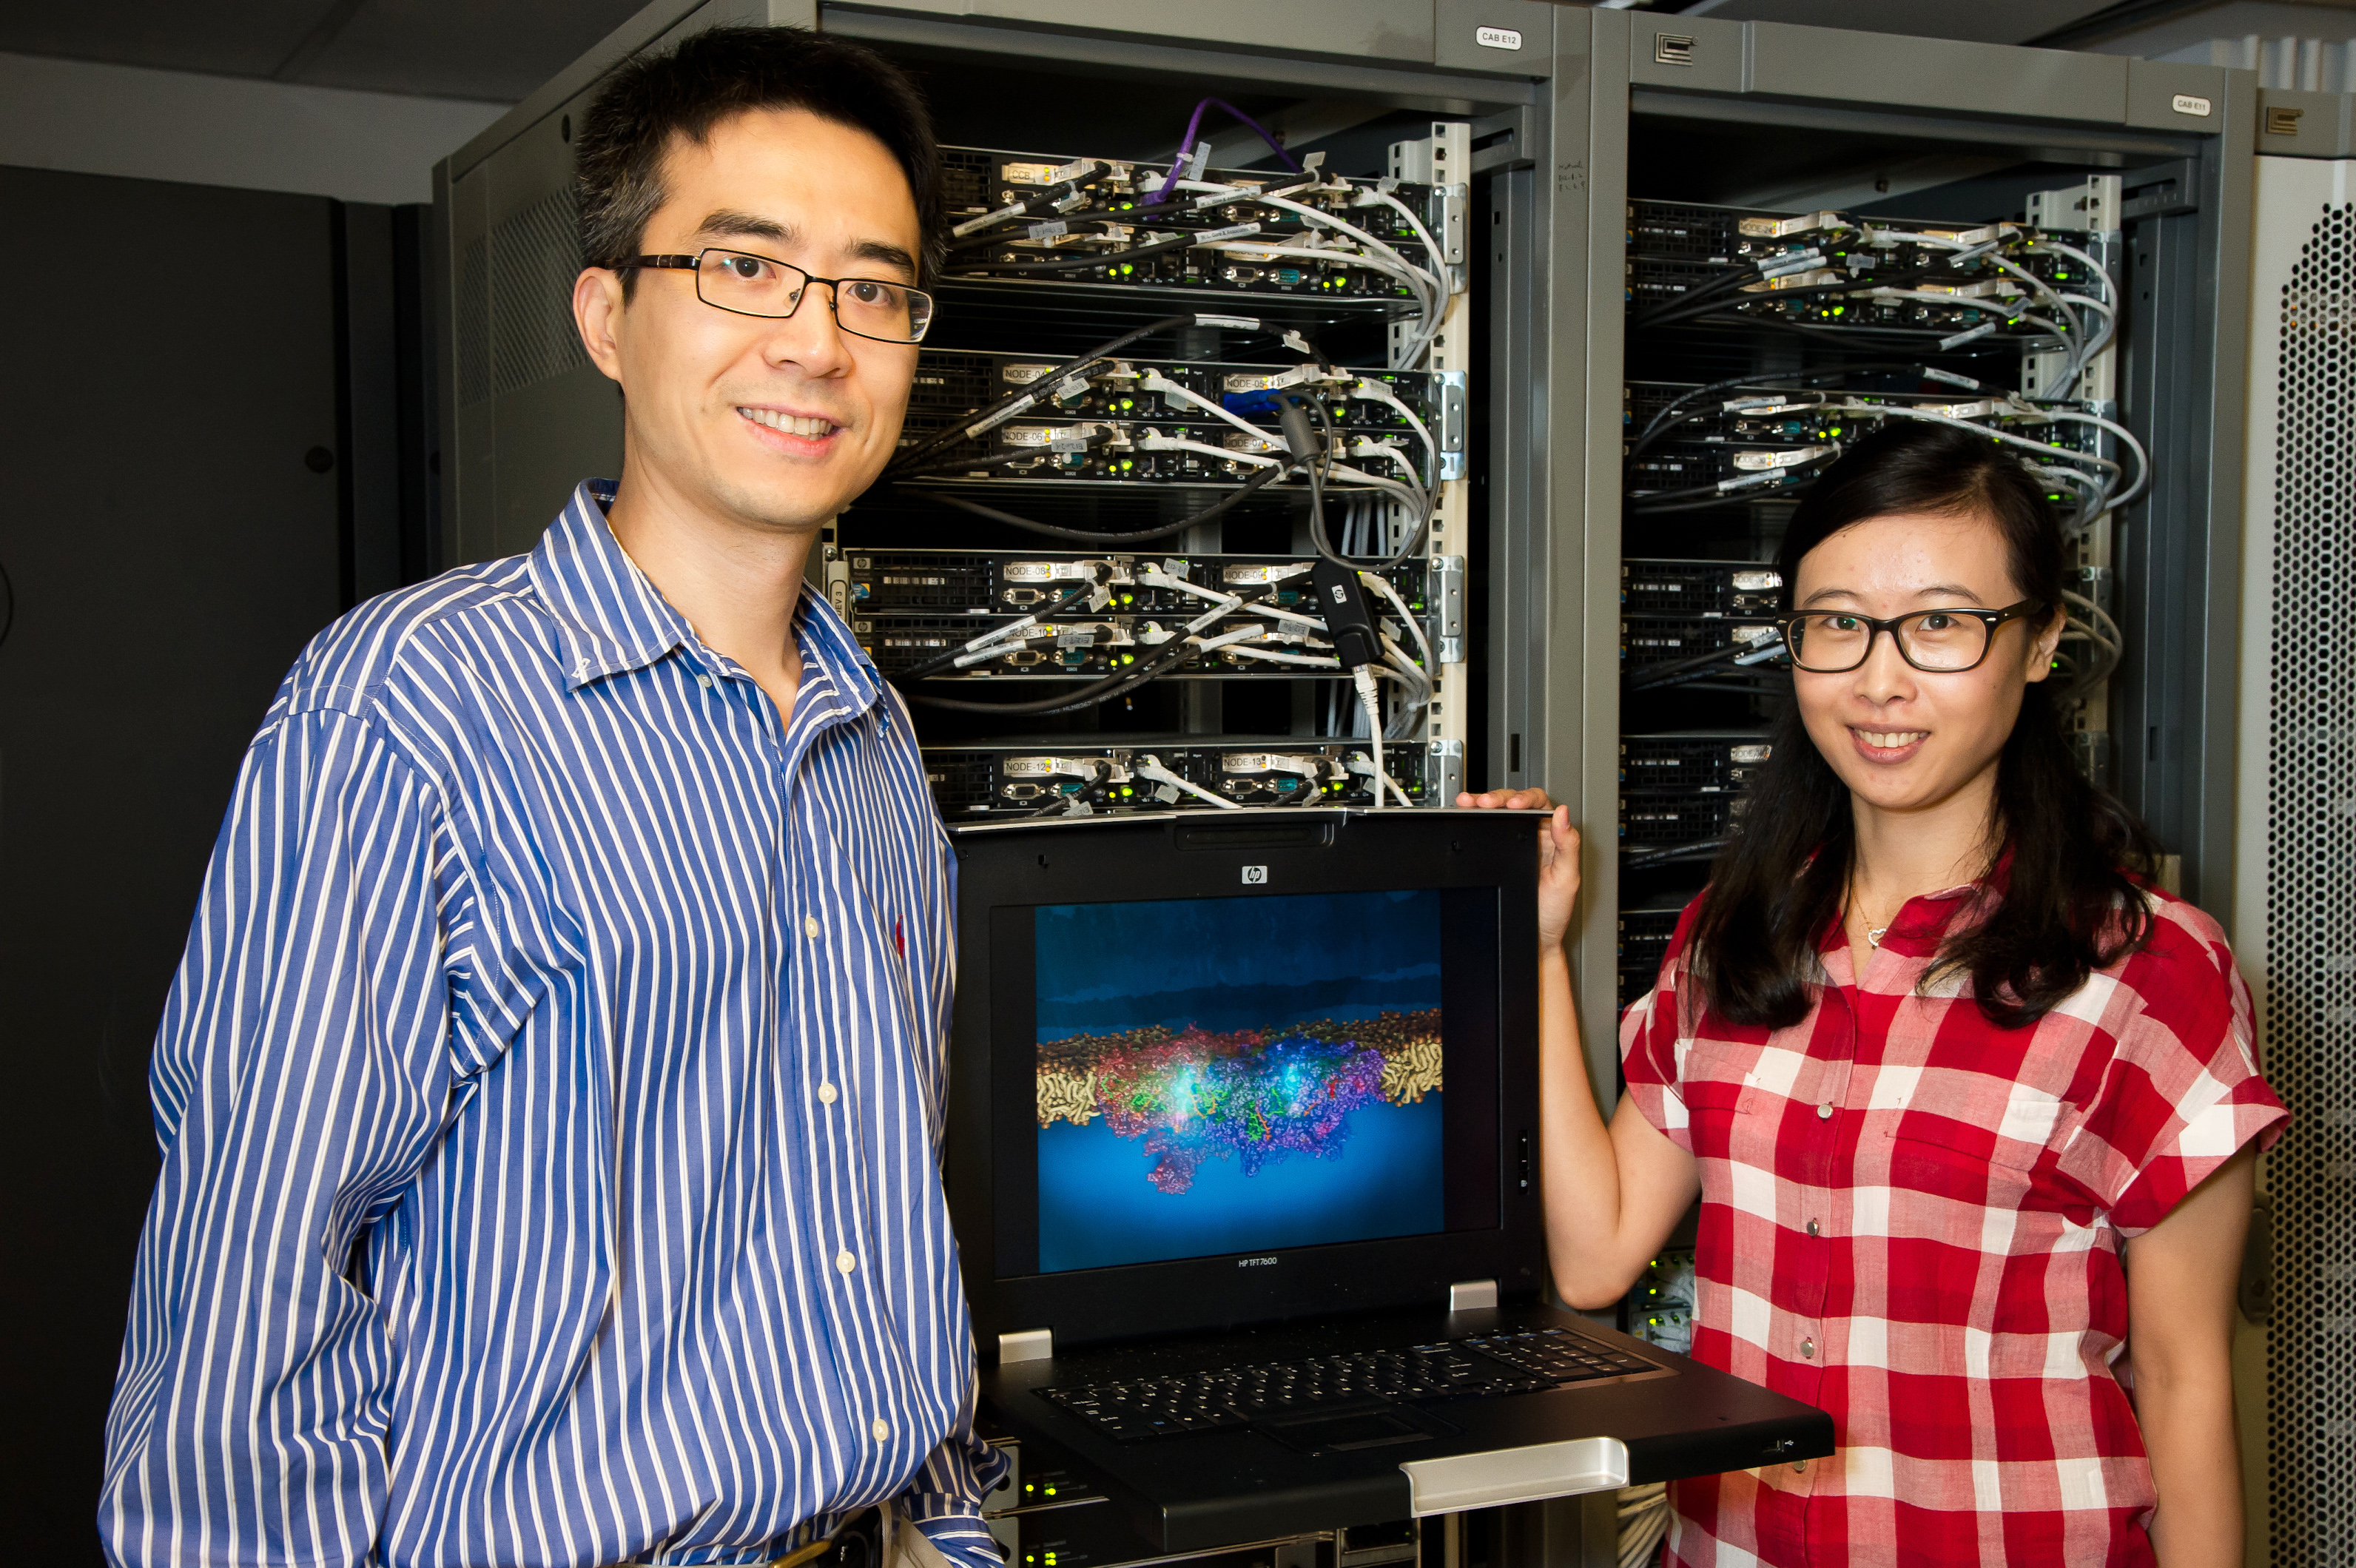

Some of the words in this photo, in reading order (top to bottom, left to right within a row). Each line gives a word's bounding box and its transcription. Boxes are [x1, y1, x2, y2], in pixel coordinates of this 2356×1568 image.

[1482, 32, 1500, 41] CAB
[1502, 35, 1516, 44] E12
[2178, 100, 2192, 109] CAB
[2195, 102, 2206, 111] E11
[1012, 170, 1030, 180] CCB
[1227, 379, 1264, 388] NODE-05
[1003, 432, 1043, 441] NODE-06
[1225, 438, 1261, 447] NODE-07
[1006, 566, 1046, 575] NODE-08
[1225, 571, 1263, 579] NODE-09
[1009, 629, 1047, 637] NODE-10
[1006, 762, 1046, 771] NODE-12
[1225, 758, 1262, 767] NODE-13
[1248, 867, 1262, 884] hp
[1239, 1259, 1248, 1268] HP
